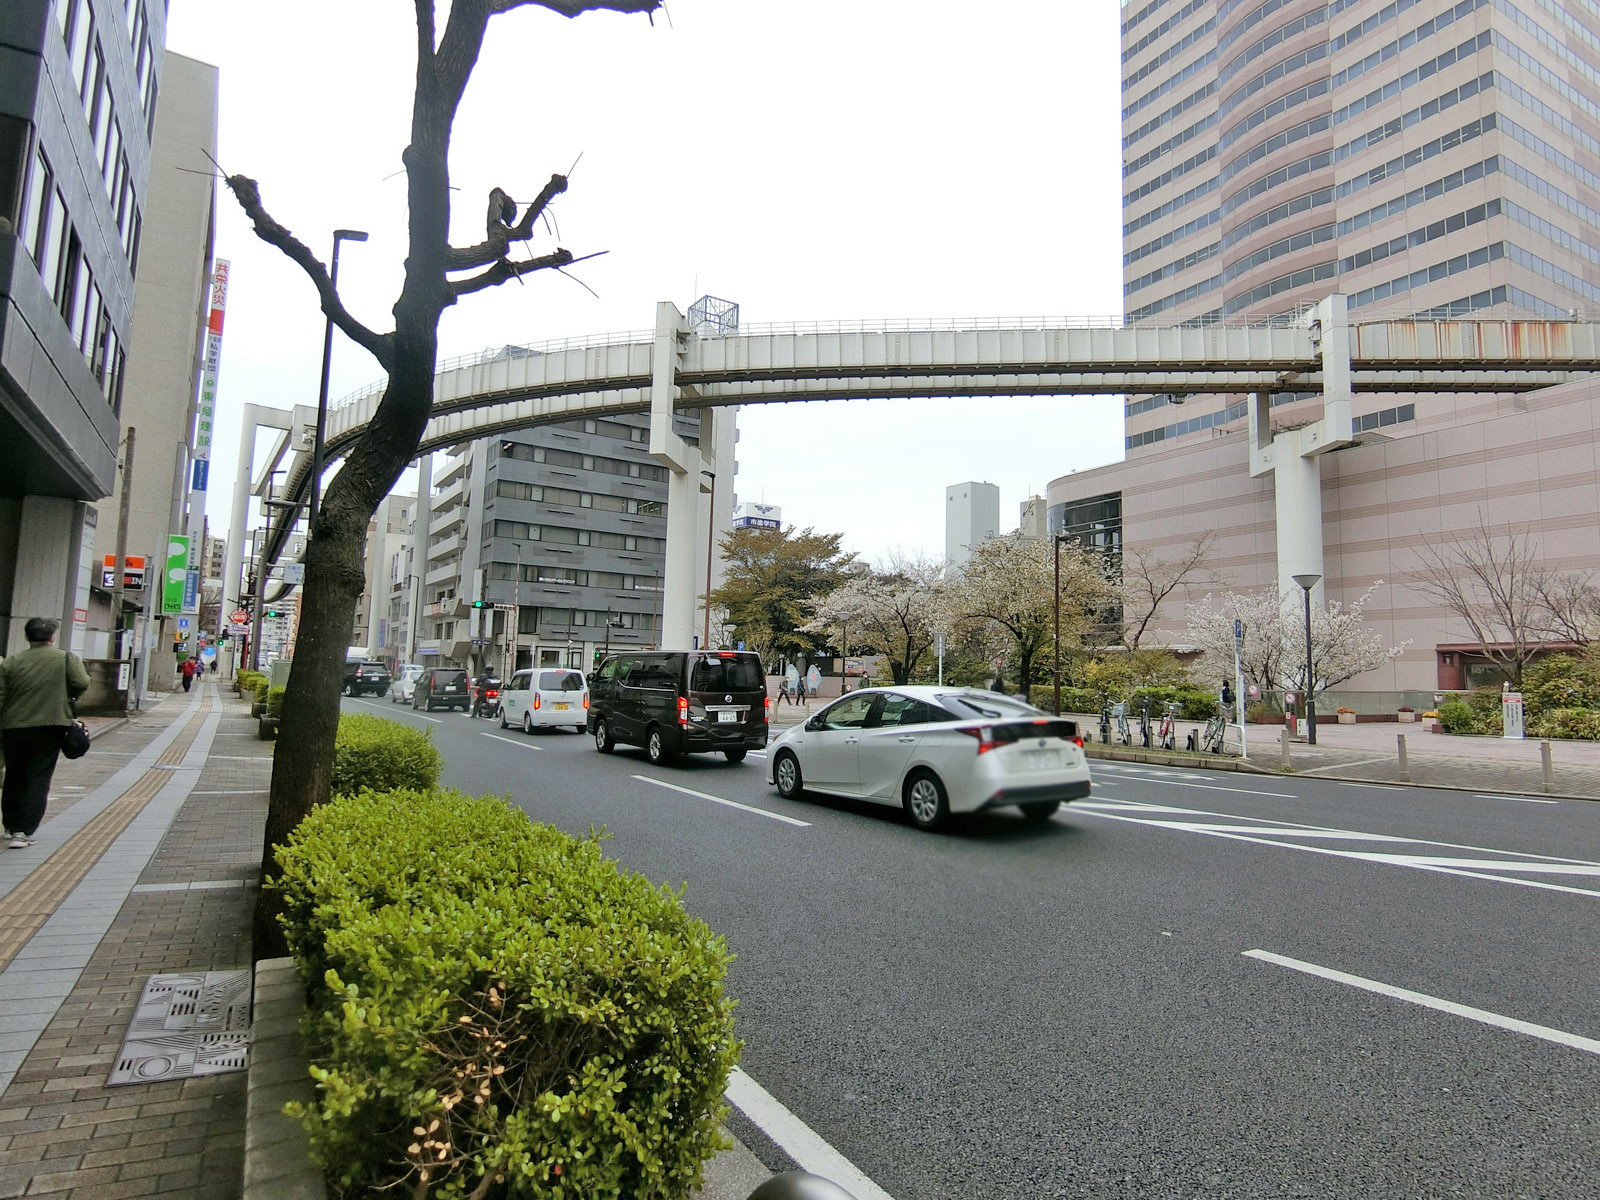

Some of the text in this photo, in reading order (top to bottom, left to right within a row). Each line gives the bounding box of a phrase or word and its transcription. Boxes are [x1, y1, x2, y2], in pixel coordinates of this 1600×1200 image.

[213, 263, 229, 305] 共栄火災
[207, 342, 219, 373] 私学財団
[198, 391, 214, 447] 東急建設
[750, 518, 777, 528] 市進学院
